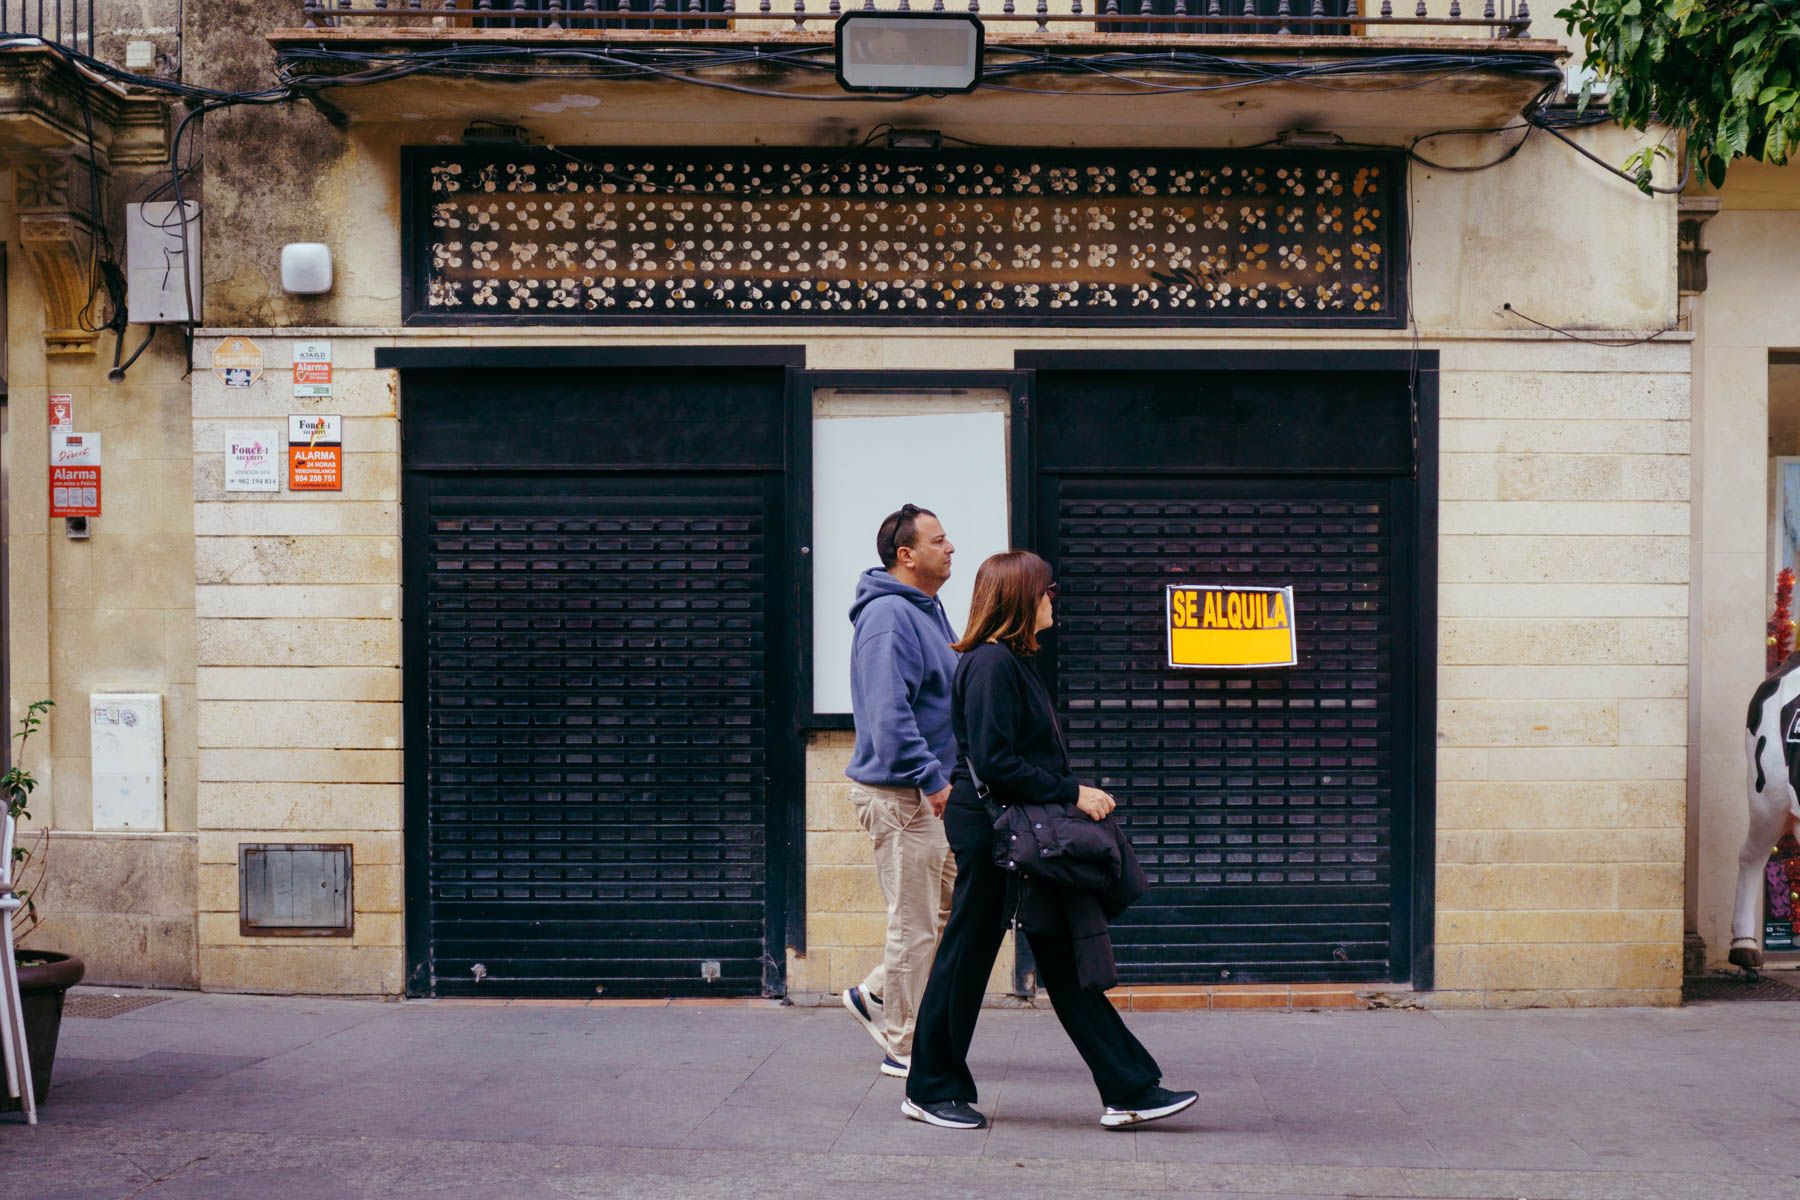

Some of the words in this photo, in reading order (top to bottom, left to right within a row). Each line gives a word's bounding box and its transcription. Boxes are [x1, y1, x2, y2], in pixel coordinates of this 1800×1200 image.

[296, 362, 329, 371] Alarma
[58, 448, 90, 461] Direct
[294, 451, 336, 460] ALARMA
[53, 468, 97, 480] Alarma
[294, 474, 308, 482] 954
[324, 474, 336, 482] 751
[1173, 590, 1198, 628] SE
[1203, 591, 1288, 630] ALQUILA
